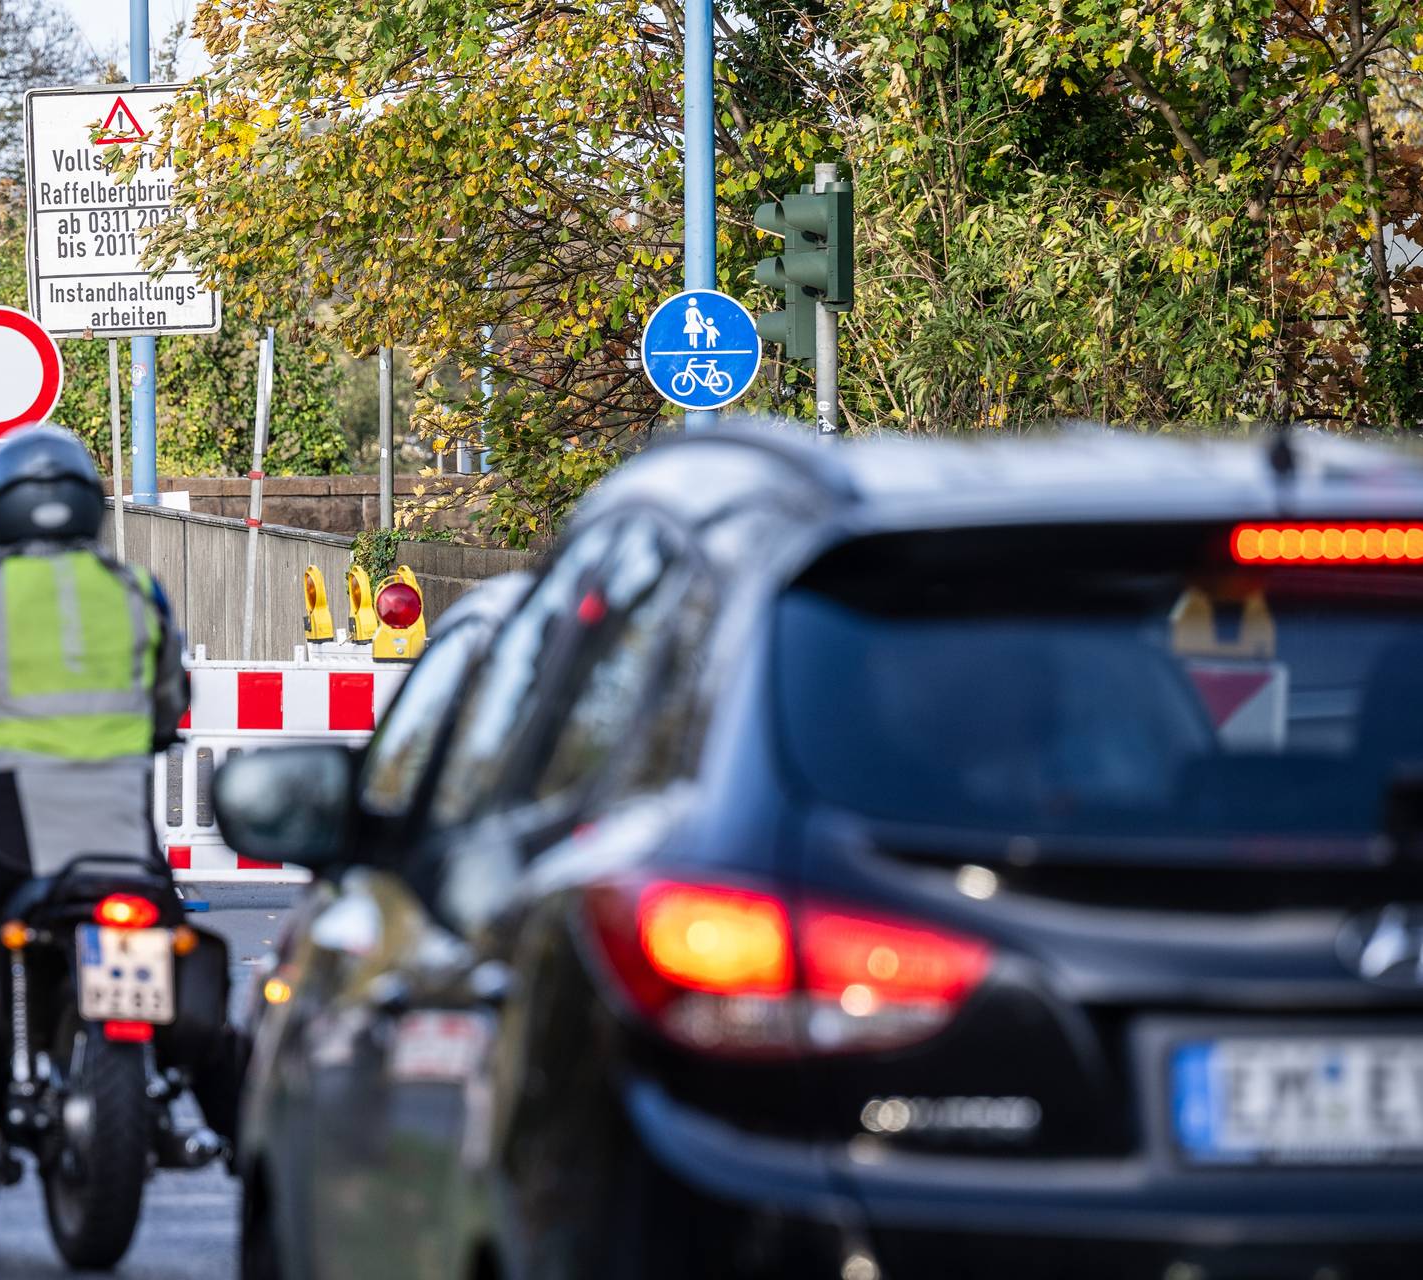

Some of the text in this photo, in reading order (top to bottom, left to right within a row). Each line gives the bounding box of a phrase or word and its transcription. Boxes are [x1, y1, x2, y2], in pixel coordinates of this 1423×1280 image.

[41, 178, 181, 207] Raffelbergbrüc
[58, 213, 81, 235] ab
[57, 235, 87, 259] bis
[49, 281, 207, 306] Instandhaltungs-
[91, 306, 167, 327] arbeiten
